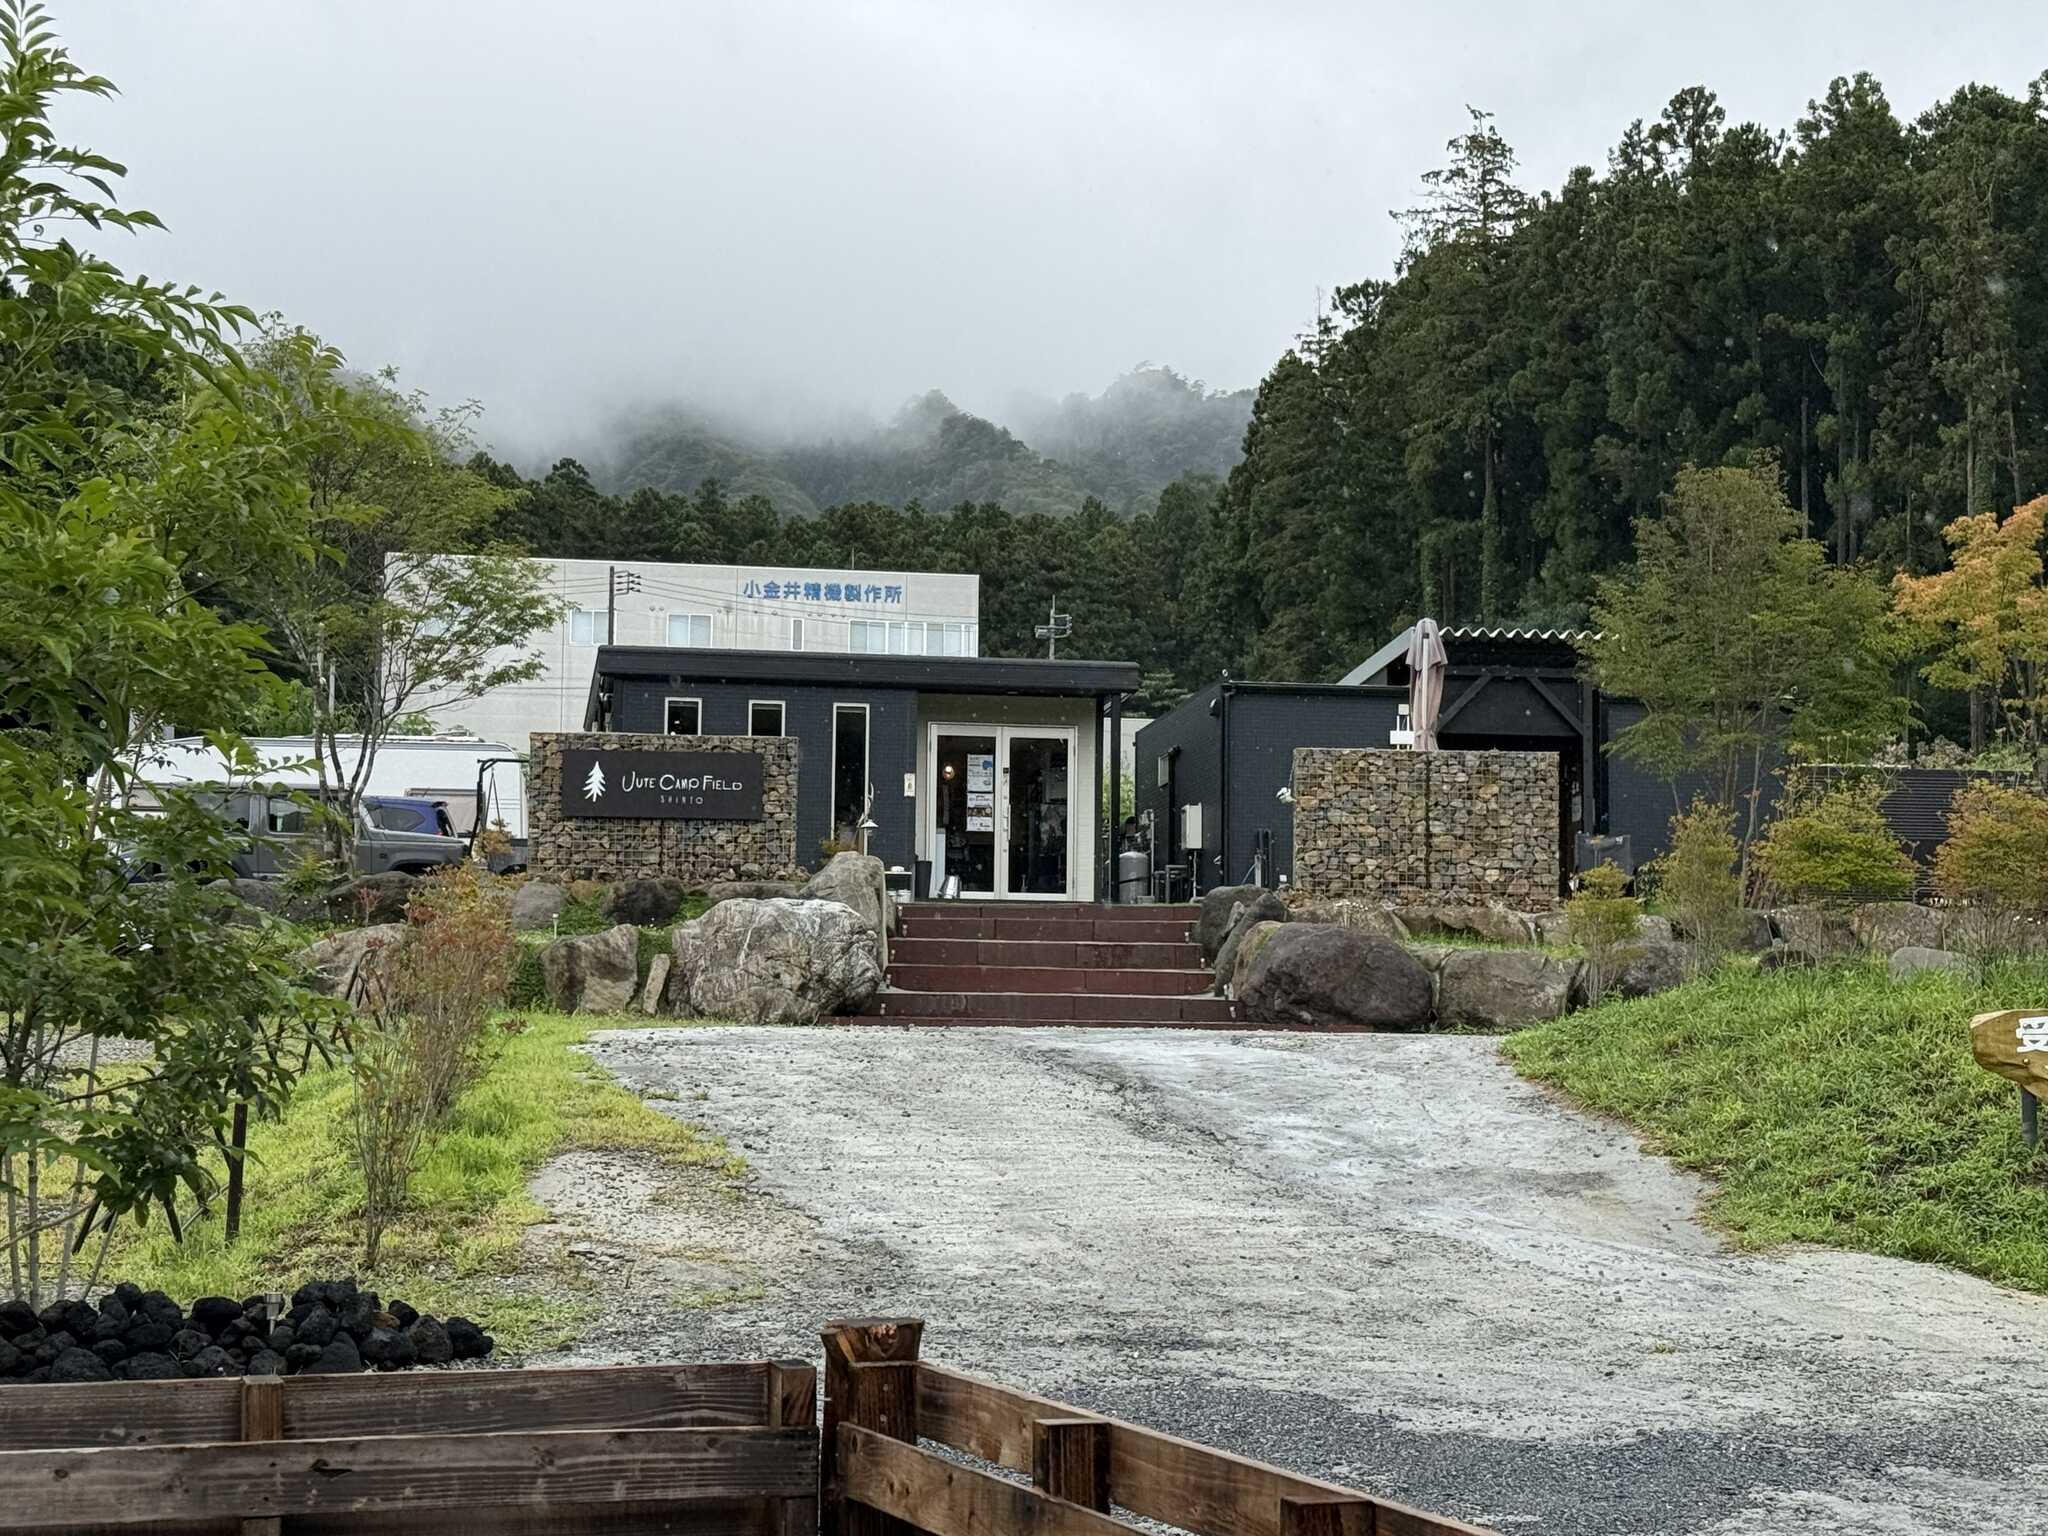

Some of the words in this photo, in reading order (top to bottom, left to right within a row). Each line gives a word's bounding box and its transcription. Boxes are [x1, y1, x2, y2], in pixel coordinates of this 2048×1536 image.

[743, 579, 902, 604] 小金井精機製作所
[659, 774, 700, 791] CAMP
[702, 775, 743, 791] FIELD
